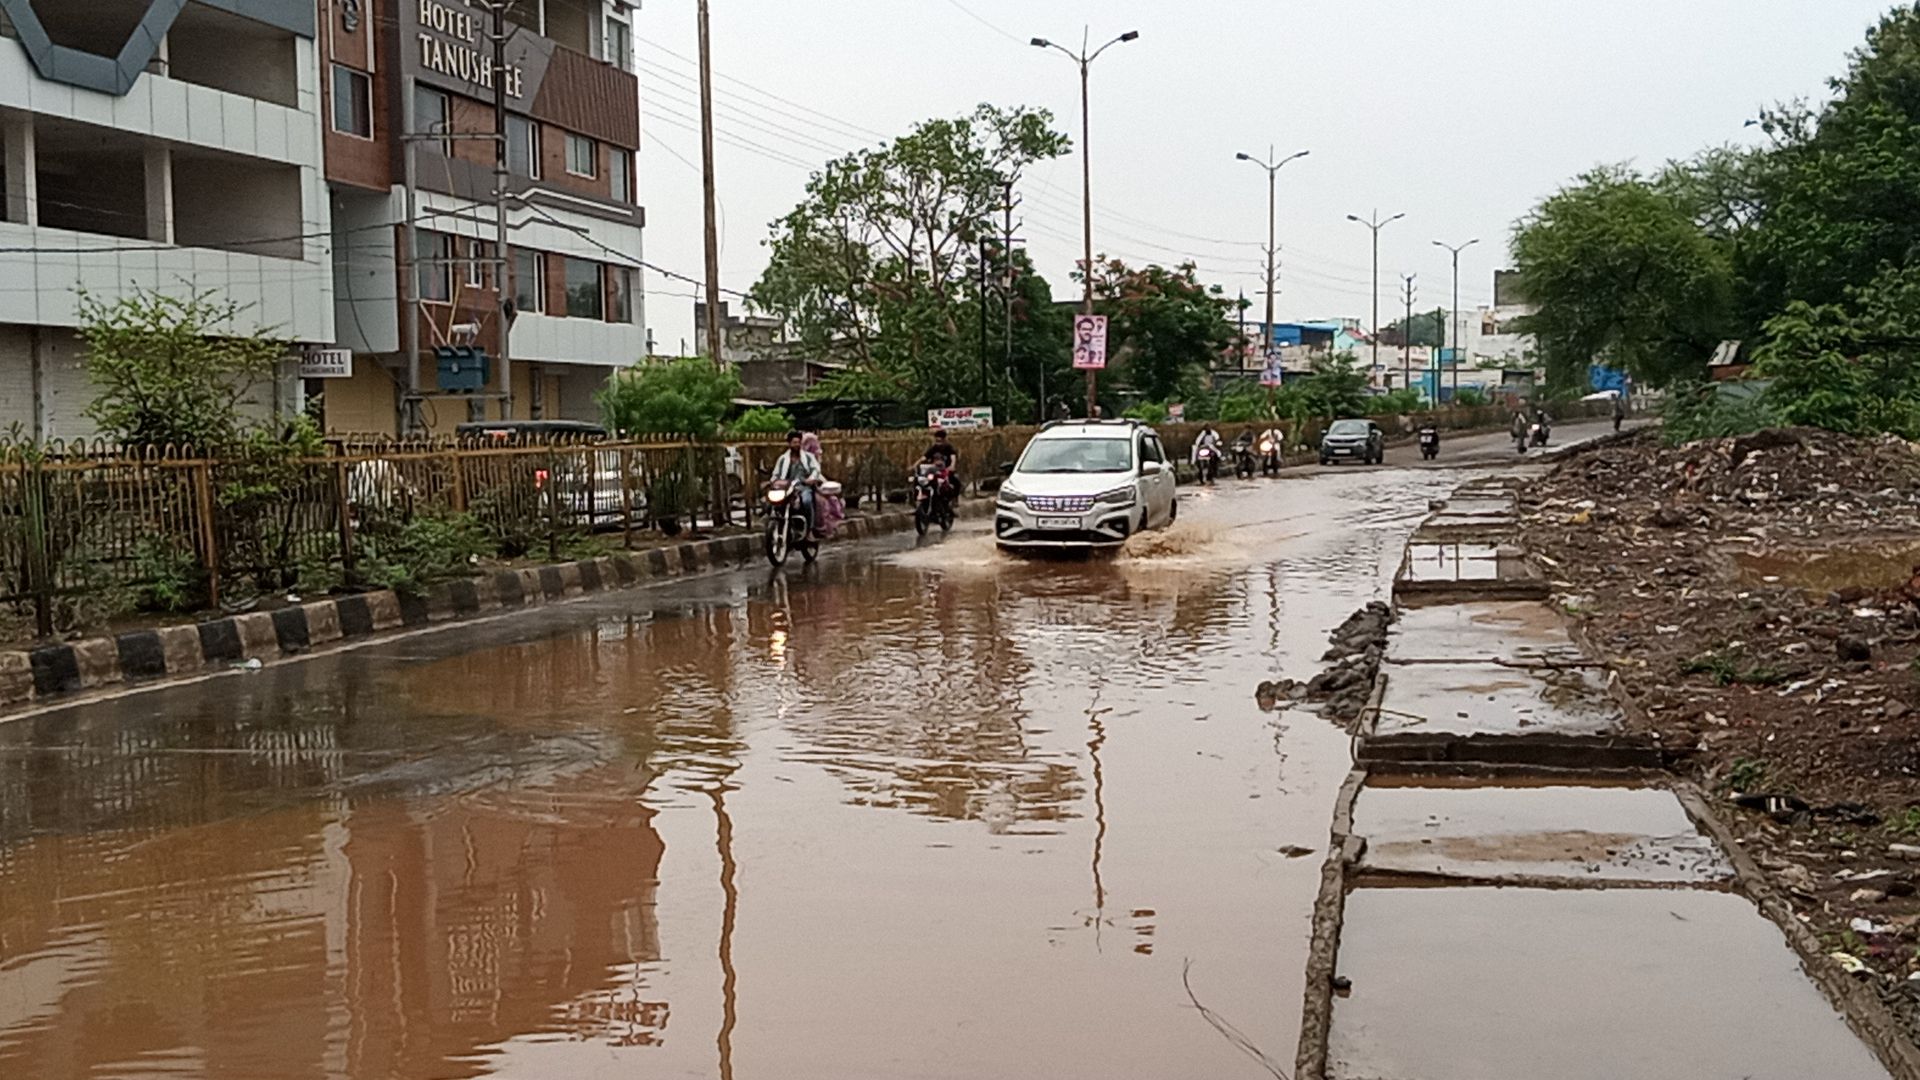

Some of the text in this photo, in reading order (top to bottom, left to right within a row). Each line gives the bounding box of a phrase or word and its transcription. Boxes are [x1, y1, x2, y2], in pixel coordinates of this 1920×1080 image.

[420, 0, 475, 42] HOTEL
[419, 33, 522, 98] TANUSHEE
[302, 351, 345, 365] HOTEL
